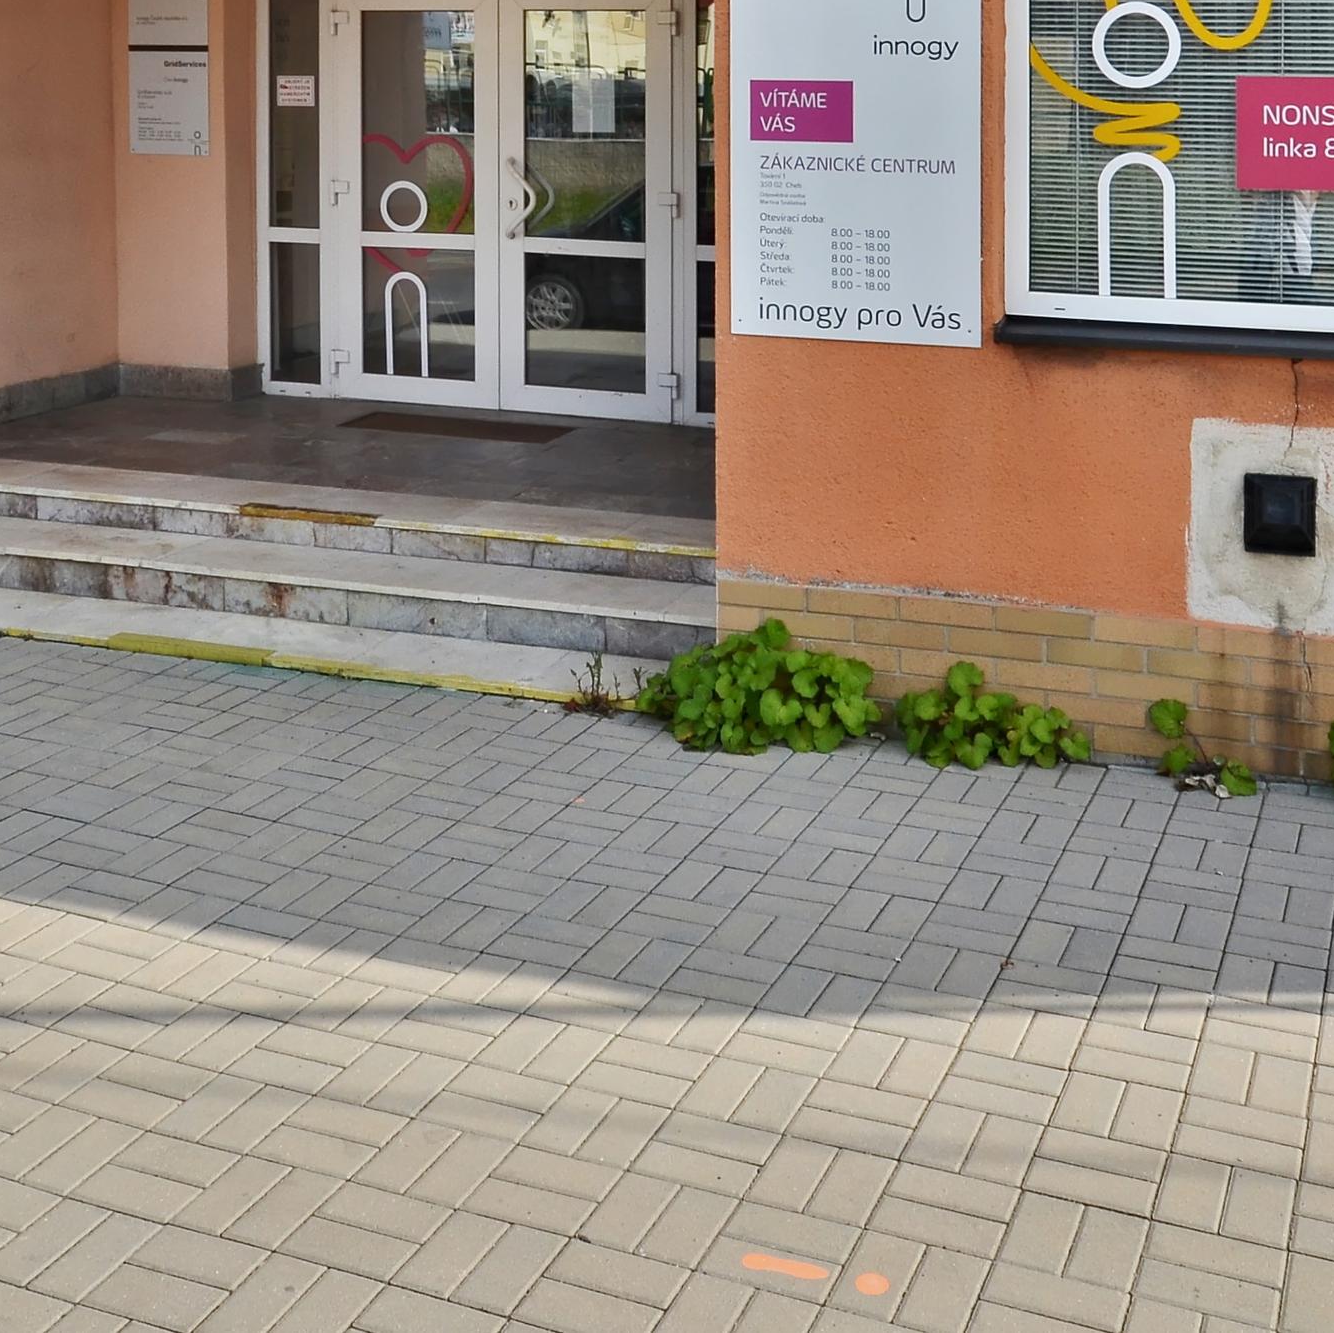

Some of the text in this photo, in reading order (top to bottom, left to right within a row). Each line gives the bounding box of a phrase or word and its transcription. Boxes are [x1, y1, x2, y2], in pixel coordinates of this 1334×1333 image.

[873, 34, 959, 61] innogy
[760, 88, 827, 109] VÍTÁME
[760, 113, 796, 133] VÁS
[1263, 136, 1317, 158] linka
[760, 152, 956, 175] ZÁKAZNICKÉ CENTRUM
[759, 296, 961, 331] innogy pro Vás
